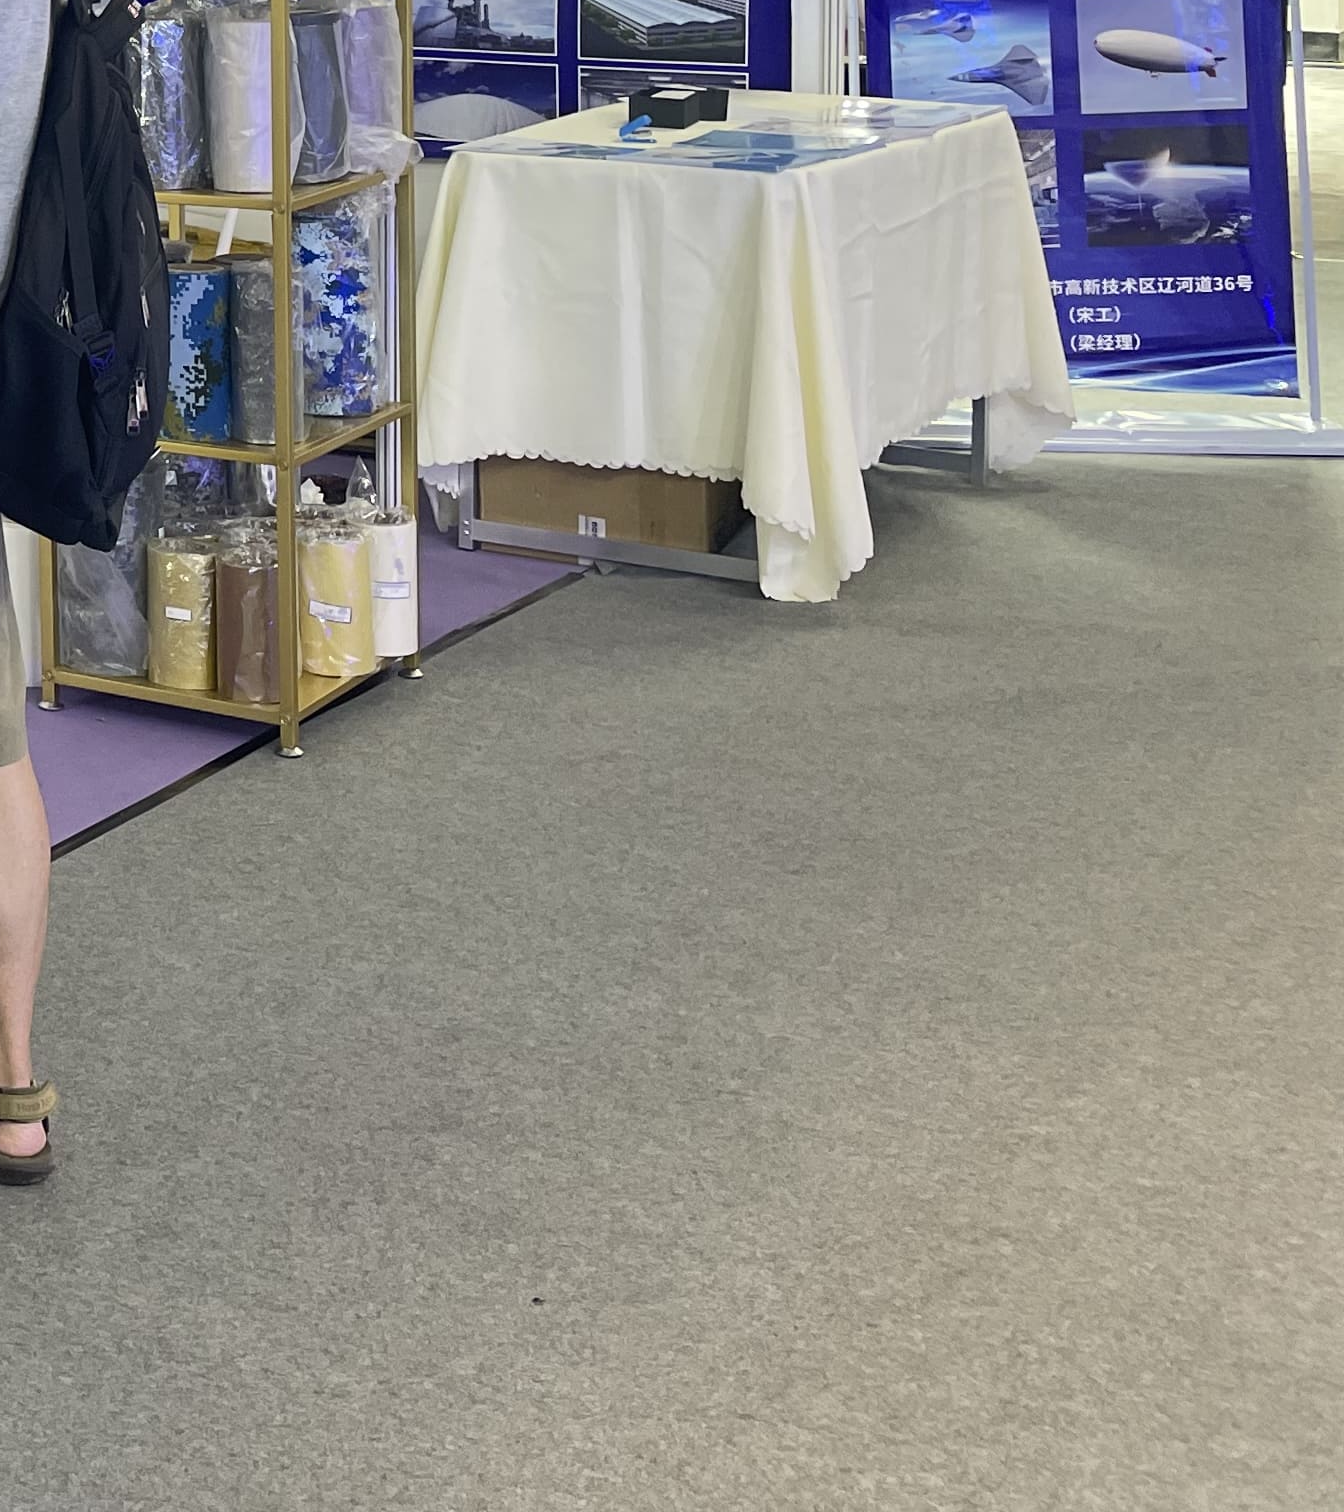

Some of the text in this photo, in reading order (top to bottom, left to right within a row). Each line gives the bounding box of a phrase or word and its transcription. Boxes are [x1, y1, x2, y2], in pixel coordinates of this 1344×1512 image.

[1048, 276, 1254, 297] 市高新技术区辽河道36号
[1068, 305, 1122, 324] （宋工）
[1069, 333, 1143, 352] （梁经理）
